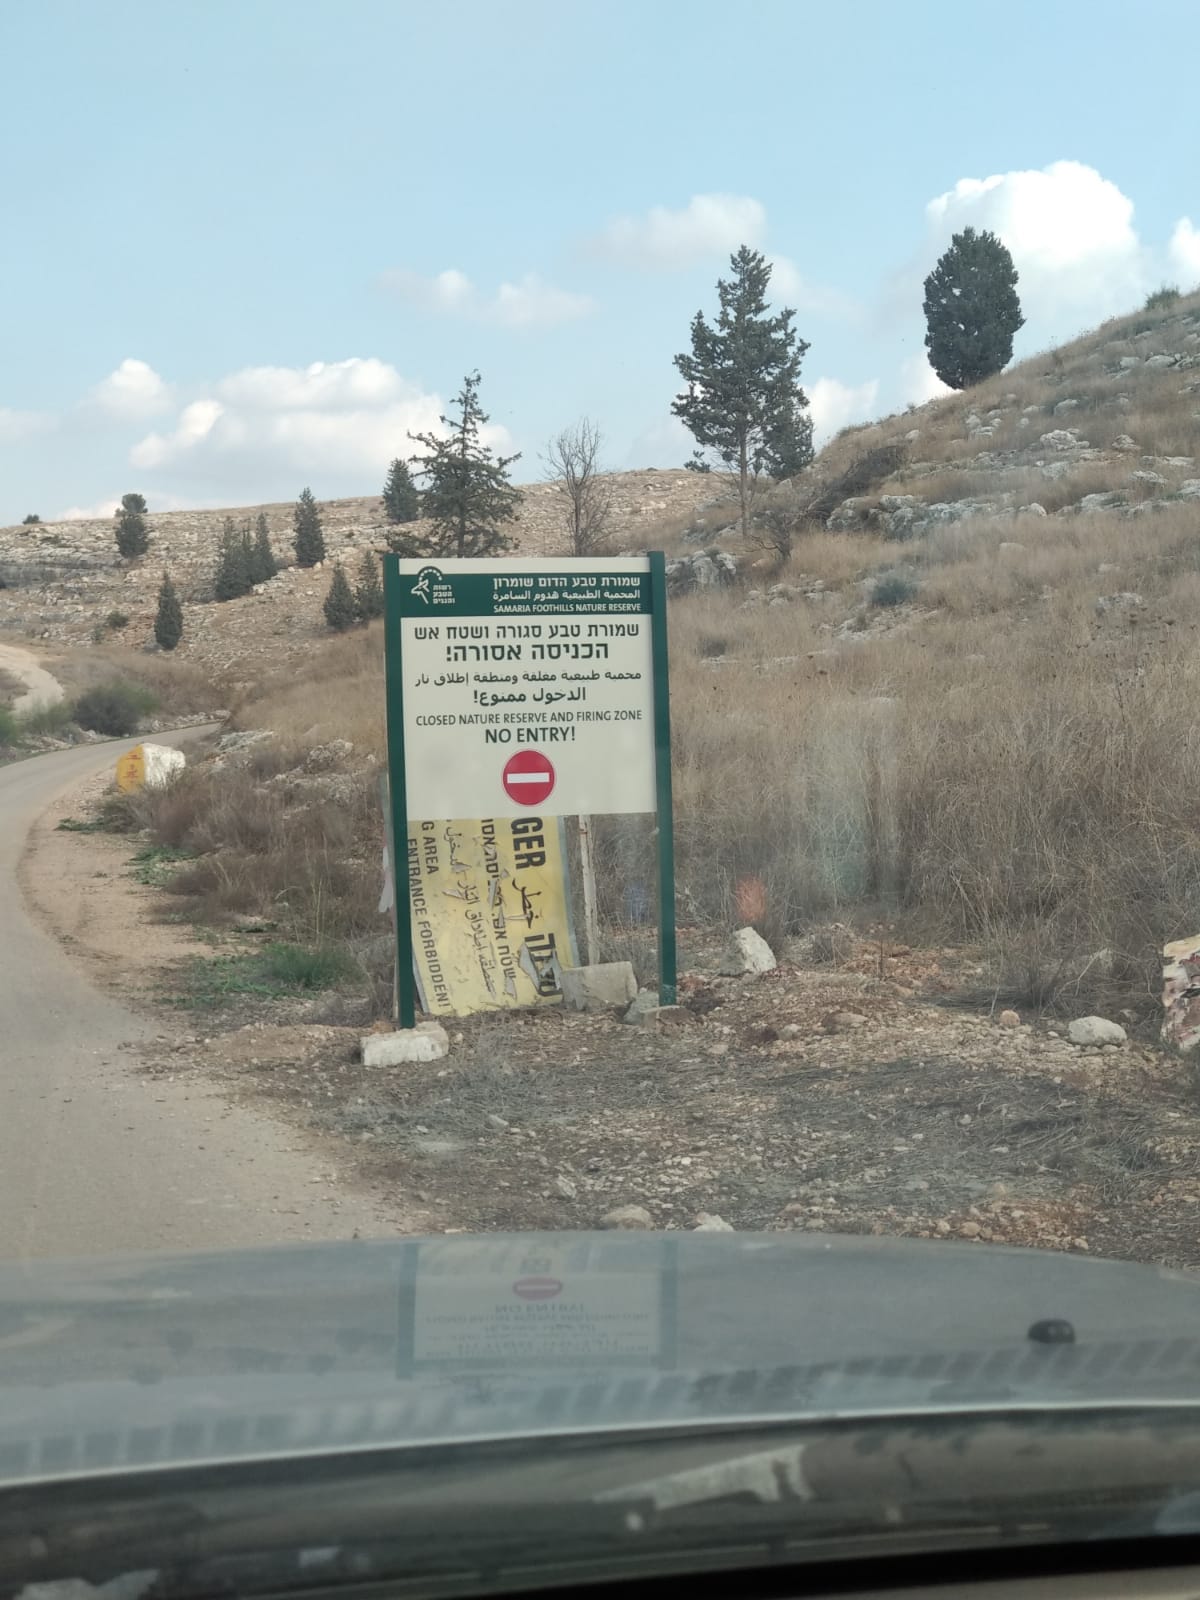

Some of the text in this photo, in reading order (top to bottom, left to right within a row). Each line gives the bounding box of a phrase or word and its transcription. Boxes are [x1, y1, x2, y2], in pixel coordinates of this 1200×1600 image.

[493, 577, 640, 590] שמורת טבע הדום שומרון
[493, 603, 641, 613] SAMARIA FOOTHILLS NATURE RESERVE
[414, 622, 640, 640] שמורת טבע סגורה ושטח אש
[446, 643, 609, 662] הכניסה אסורה!
[473, 687, 586, 706] الدخول ممنوع!
[416, 710, 642, 726] CLOSED NATURE RESERVE AND FIRING ZONE
[485, 726, 576, 744] NO ENTRY!
[423, 836, 440, 875] AREA
[407, 838, 451, 1007] ENTRANCE FORBIDDEN!
